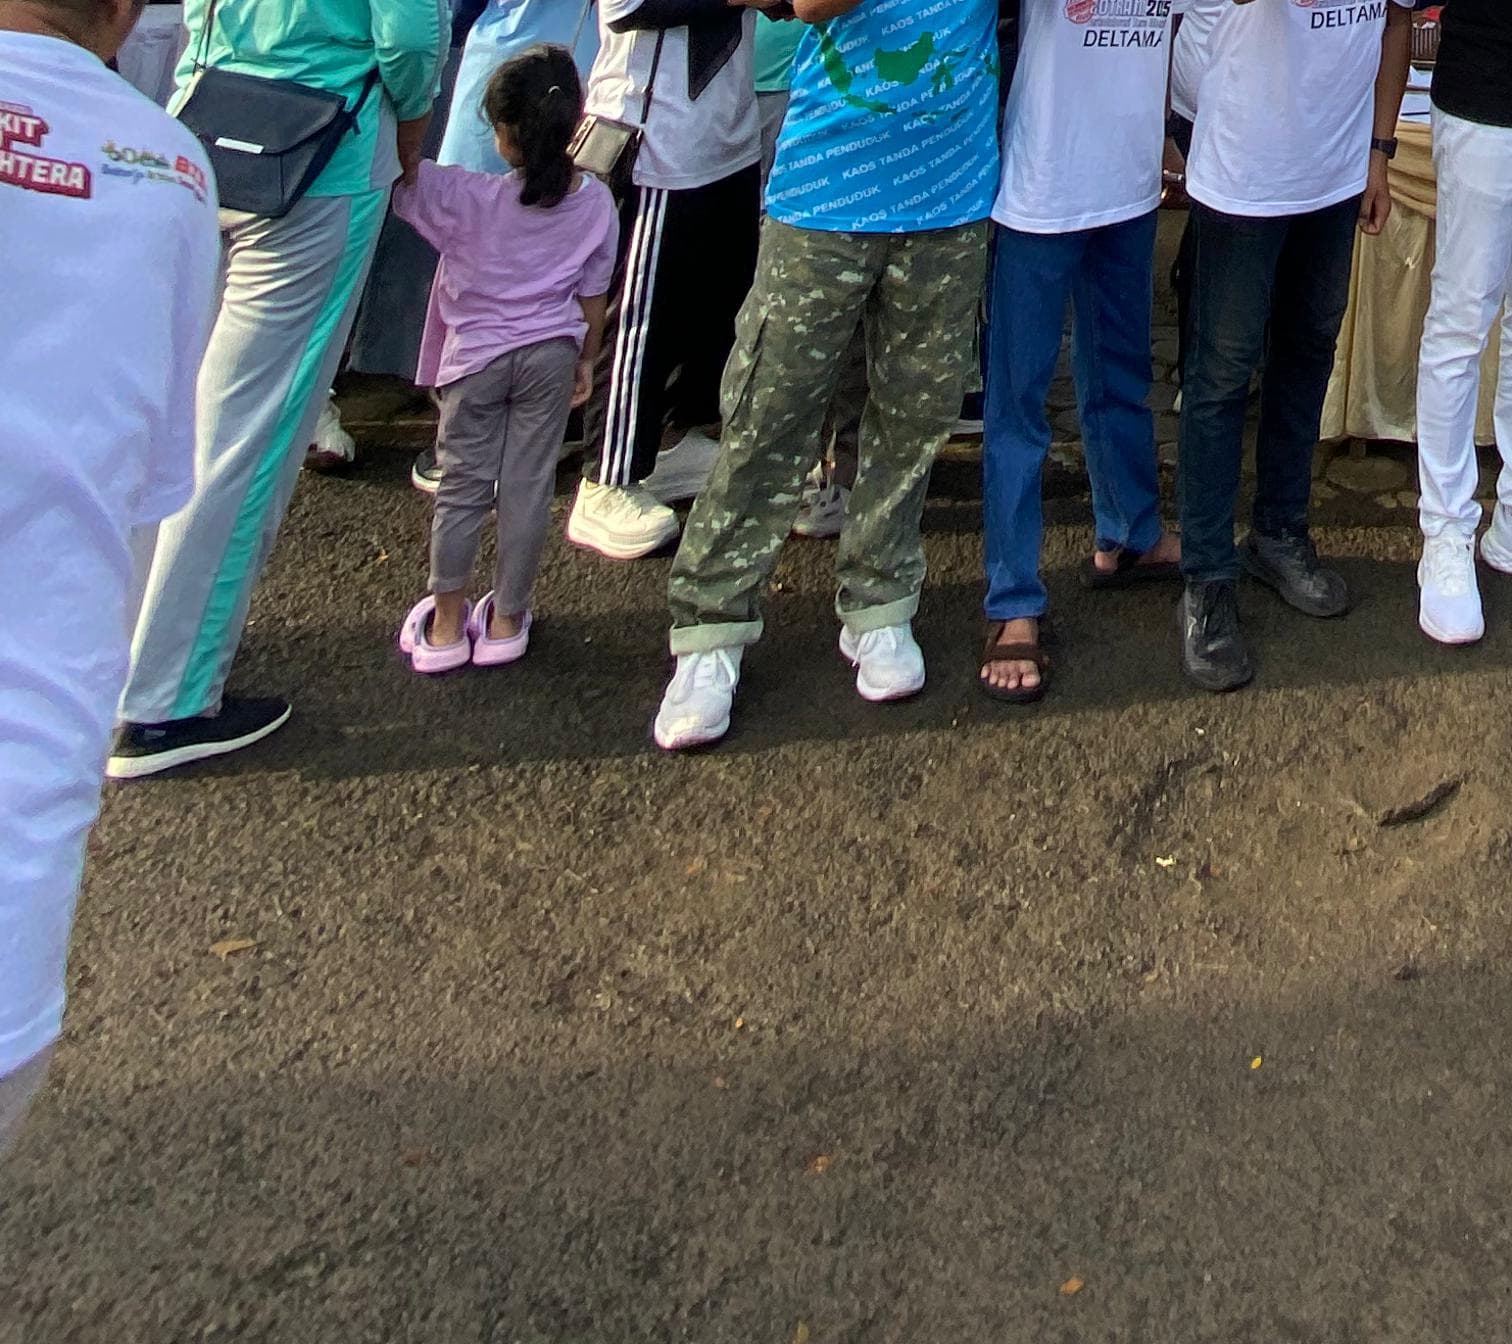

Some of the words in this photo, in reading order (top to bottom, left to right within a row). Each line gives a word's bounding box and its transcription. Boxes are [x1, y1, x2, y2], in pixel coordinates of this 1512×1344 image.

[881, 16, 914, 36] KAOS
[916, 0, 951, 20] TANDA
[789, 153, 824, 171] TANDA
[825, 131, 891, 159] PENDUDUK
[842, 160, 877, 180] KAOS
[879, 143, 919, 165] TANDA
[893, 165, 927, 186] KAOS
[929, 144, 962, 168] TANDA
[812, 184, 881, 216] PENDUDUK
[852, 208, 888, 230] KAOS
[889, 190, 930, 213] TANDA
